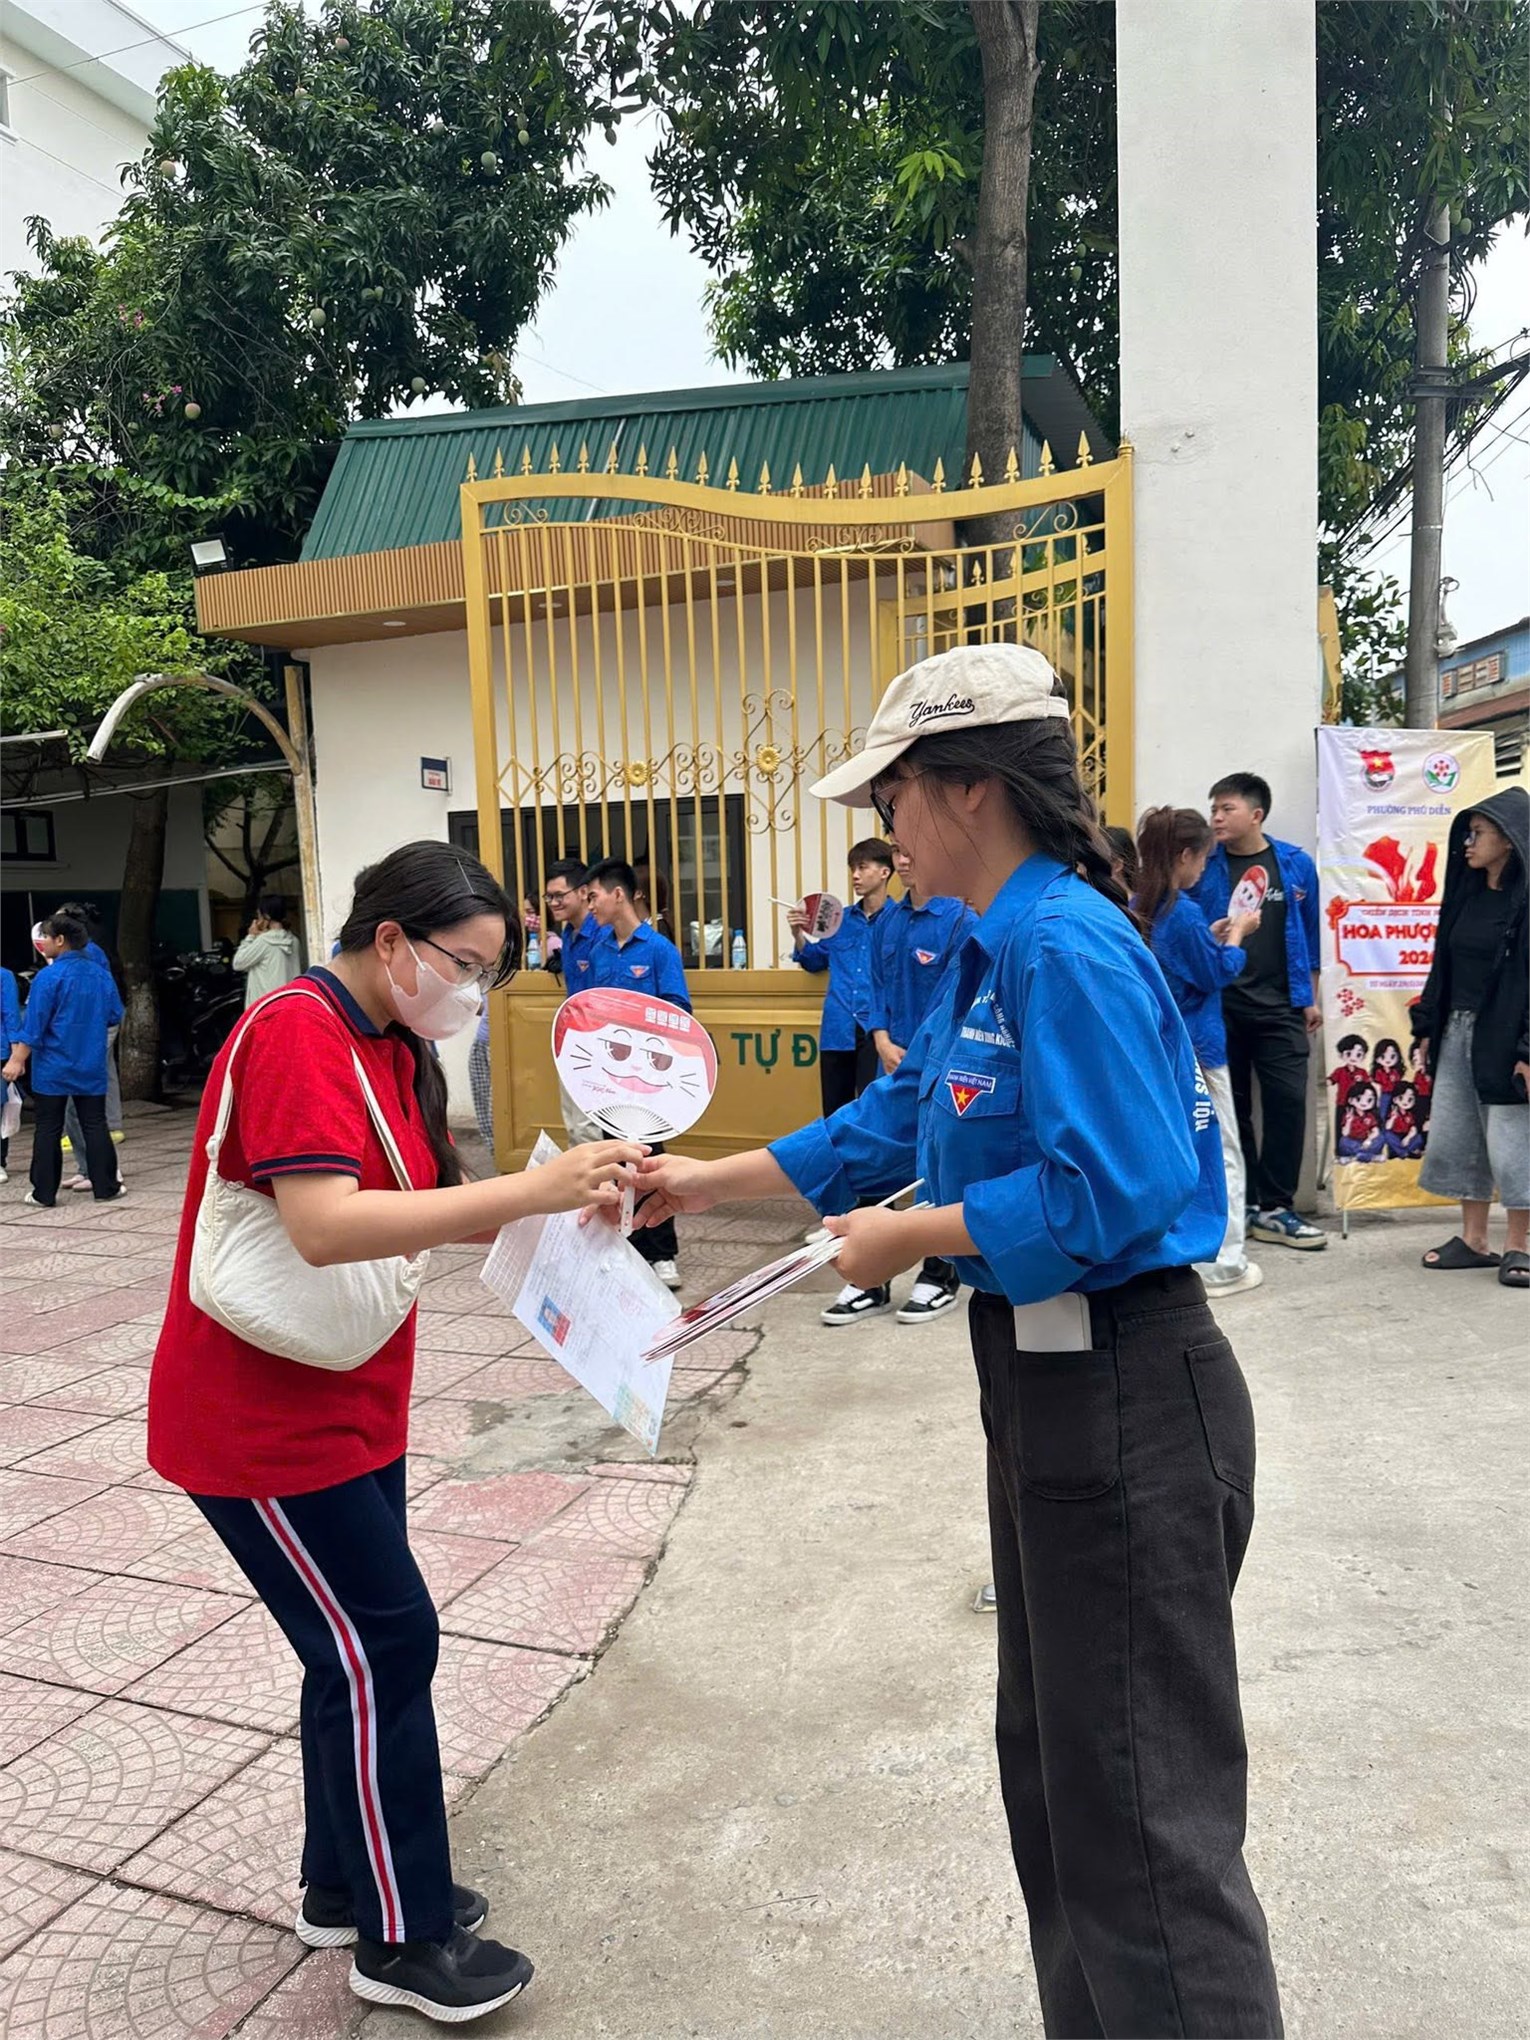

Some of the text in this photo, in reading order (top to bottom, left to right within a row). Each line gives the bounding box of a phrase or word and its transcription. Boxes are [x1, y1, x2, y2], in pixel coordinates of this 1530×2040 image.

[908, 693, 976, 728] Yankees
[1342, 922, 1438, 943] HOA PHƯỢ
[730, 1028, 818, 1074] TỰ Đ
